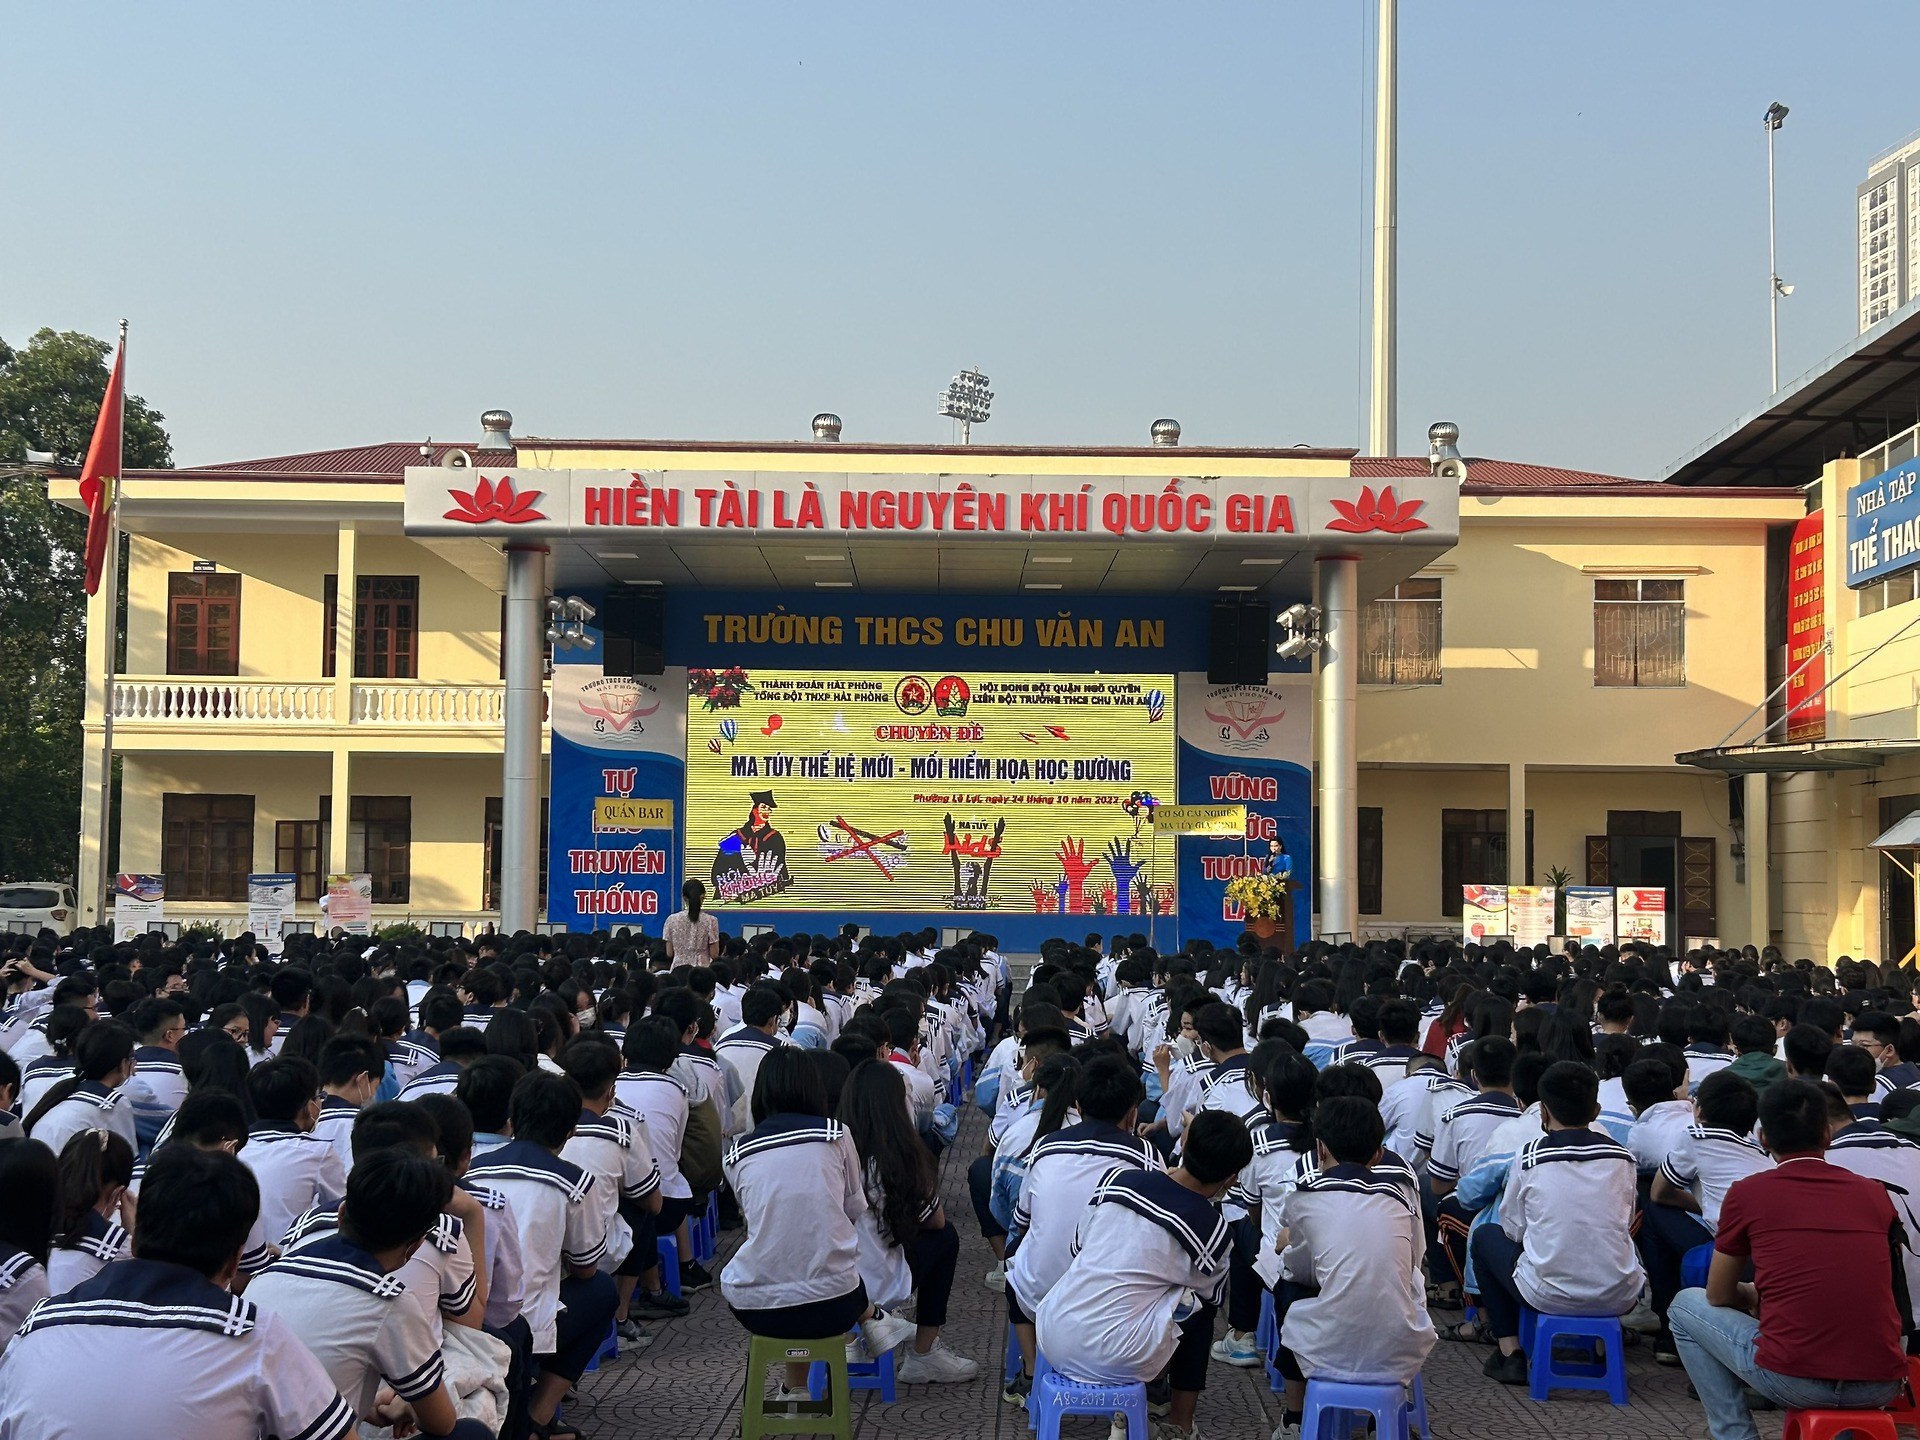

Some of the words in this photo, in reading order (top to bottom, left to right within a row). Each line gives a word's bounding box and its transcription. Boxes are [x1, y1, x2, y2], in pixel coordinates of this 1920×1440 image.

[585, 472, 681, 528] HIỀN
[694, 480, 758, 529] TÀI
[773, 481, 825, 530] LÀ
[839, 483, 1005, 531] NGUYÊN
[1019, 484, 1097, 532] KHÍ
[1101, 477, 1211, 536] QUỐC
[1225, 494, 1295, 534] GIA
[1856, 481, 1886, 518] NHÀ
[1888, 471, 1917, 504] TẬP
[1850, 518, 1879, 575] THỂ
[703, 605, 844, 646] TRƯỜNG
[856, 615, 943, 647] THCS
[955, 618, 1024, 648] CHU
[1035, 611, 1103, 648] VĂN
[1114, 618, 1165, 648] AN
[875, 723, 952, 742] CHUYÊN
[957, 721, 984, 741] ĐỀ
[602, 767, 637, 798] TỰ
[731, 755, 758, 777] MA
[763, 752, 794, 777] TÚY
[799, 750, 830, 778] THẾ
[835, 753, 855, 782] HỆ
[861, 753, 893, 778] MỚI
[911, 751, 943, 779] MỐI
[949, 750, 991, 780] HIỂM
[996, 758, 1030, 784] HỌA
[1035, 759, 1068, 784] HỌC
[1073, 755, 1131, 781] ĐƯỜNG
[1209, 772, 1278, 801] VỮNG
[604, 803, 637, 820] QUÁN
[639, 806, 664, 819] BAR
[568, 843, 666, 875] TRUYỀN
[574, 882, 658, 915] THỐNG
